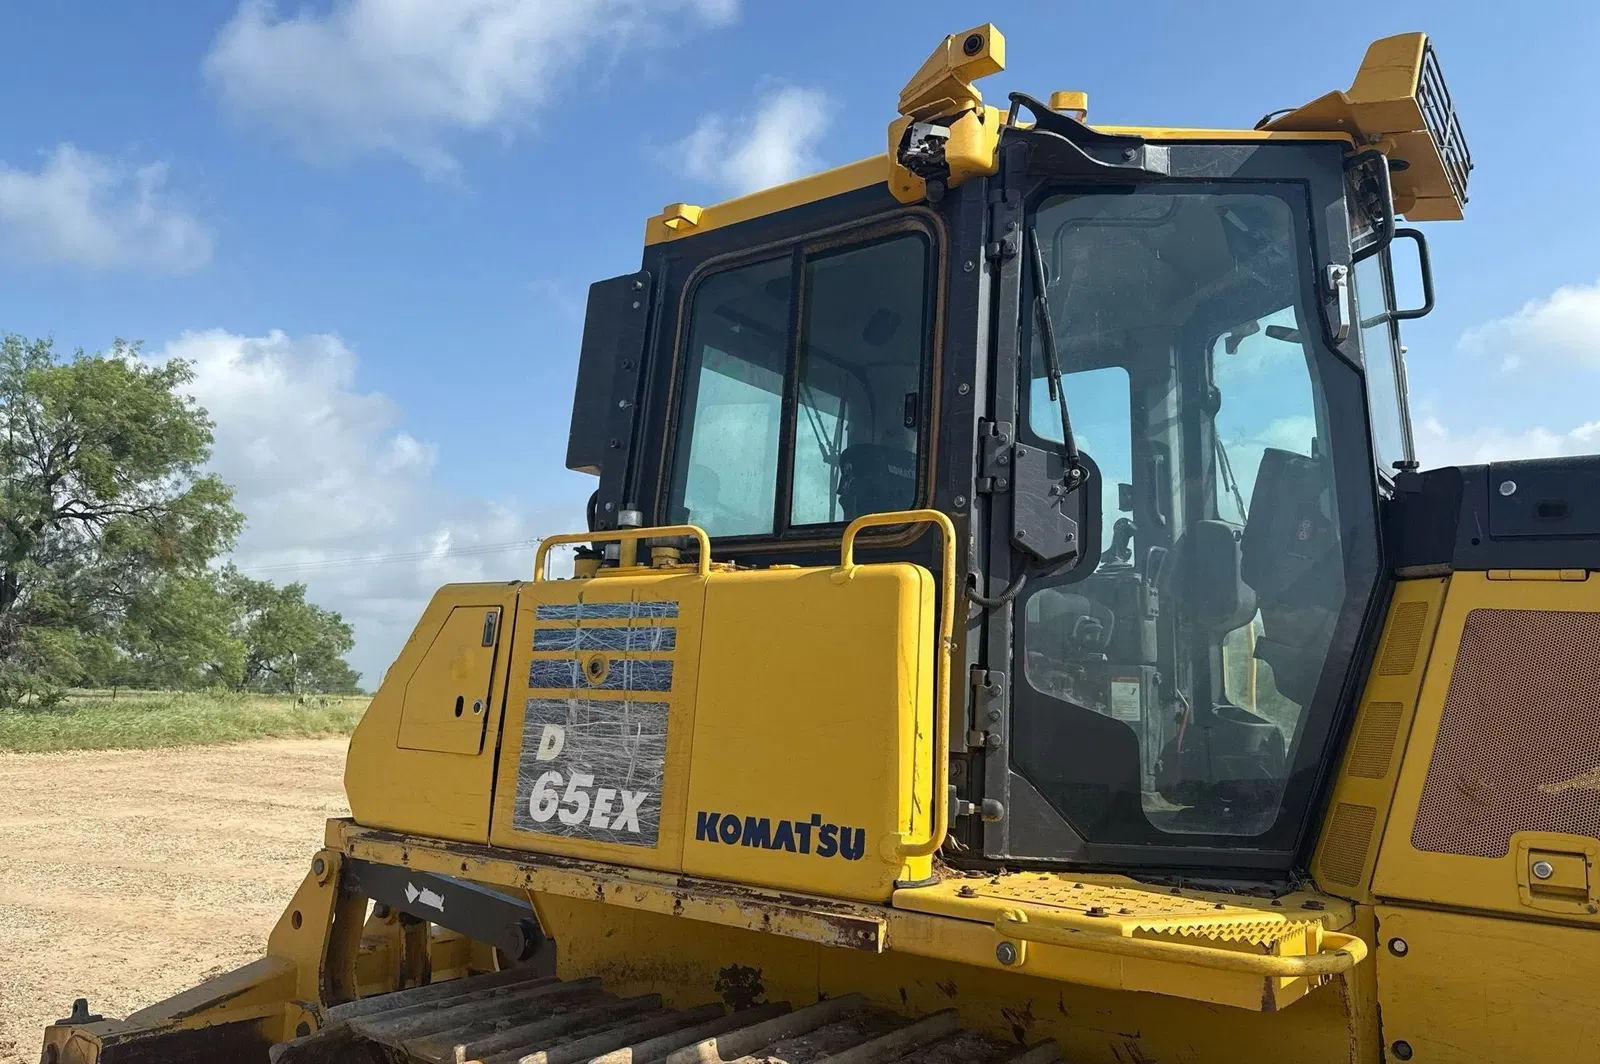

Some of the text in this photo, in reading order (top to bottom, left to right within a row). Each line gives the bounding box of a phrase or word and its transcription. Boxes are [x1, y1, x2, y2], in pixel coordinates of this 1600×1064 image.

[535, 724, 565, 761] D
[529, 770, 651, 833] 65EX
[695, 811, 866, 861] KOMATSU
